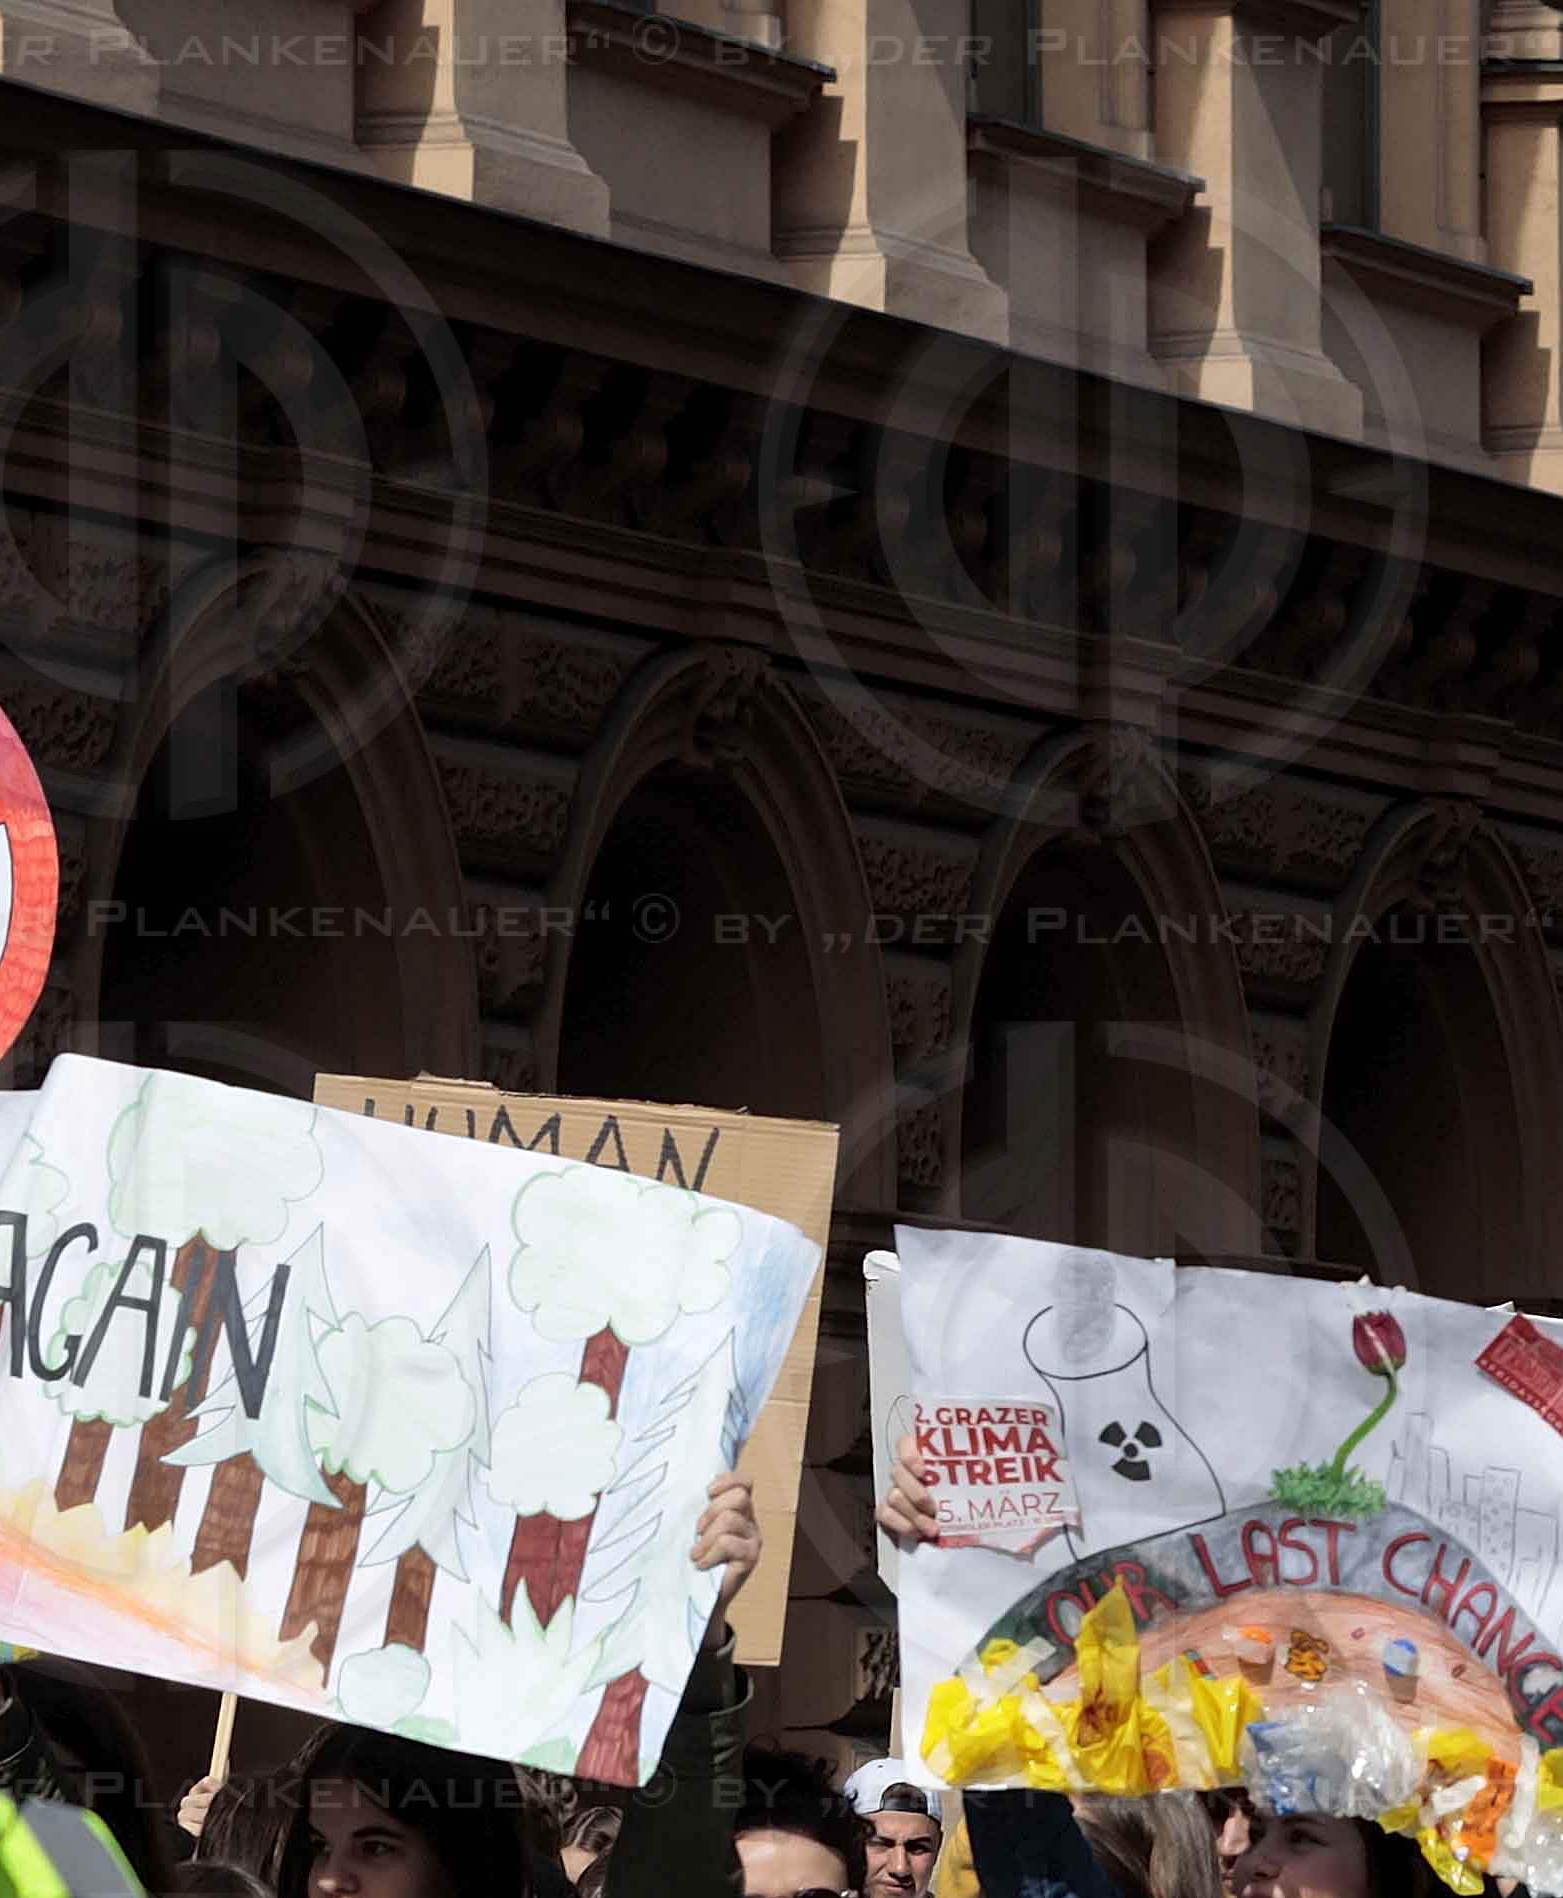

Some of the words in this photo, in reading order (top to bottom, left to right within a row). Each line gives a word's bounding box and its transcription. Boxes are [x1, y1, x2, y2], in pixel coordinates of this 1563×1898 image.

[936, 1406, 1049, 1427] GRAZER
[916, 1426, 1059, 1458] KLIMA
[923, 1454, 1065, 1487] STREIK
[967, 1490, 1065, 1523] MÄRZ
[1190, 1519, 1358, 1604] LAST
